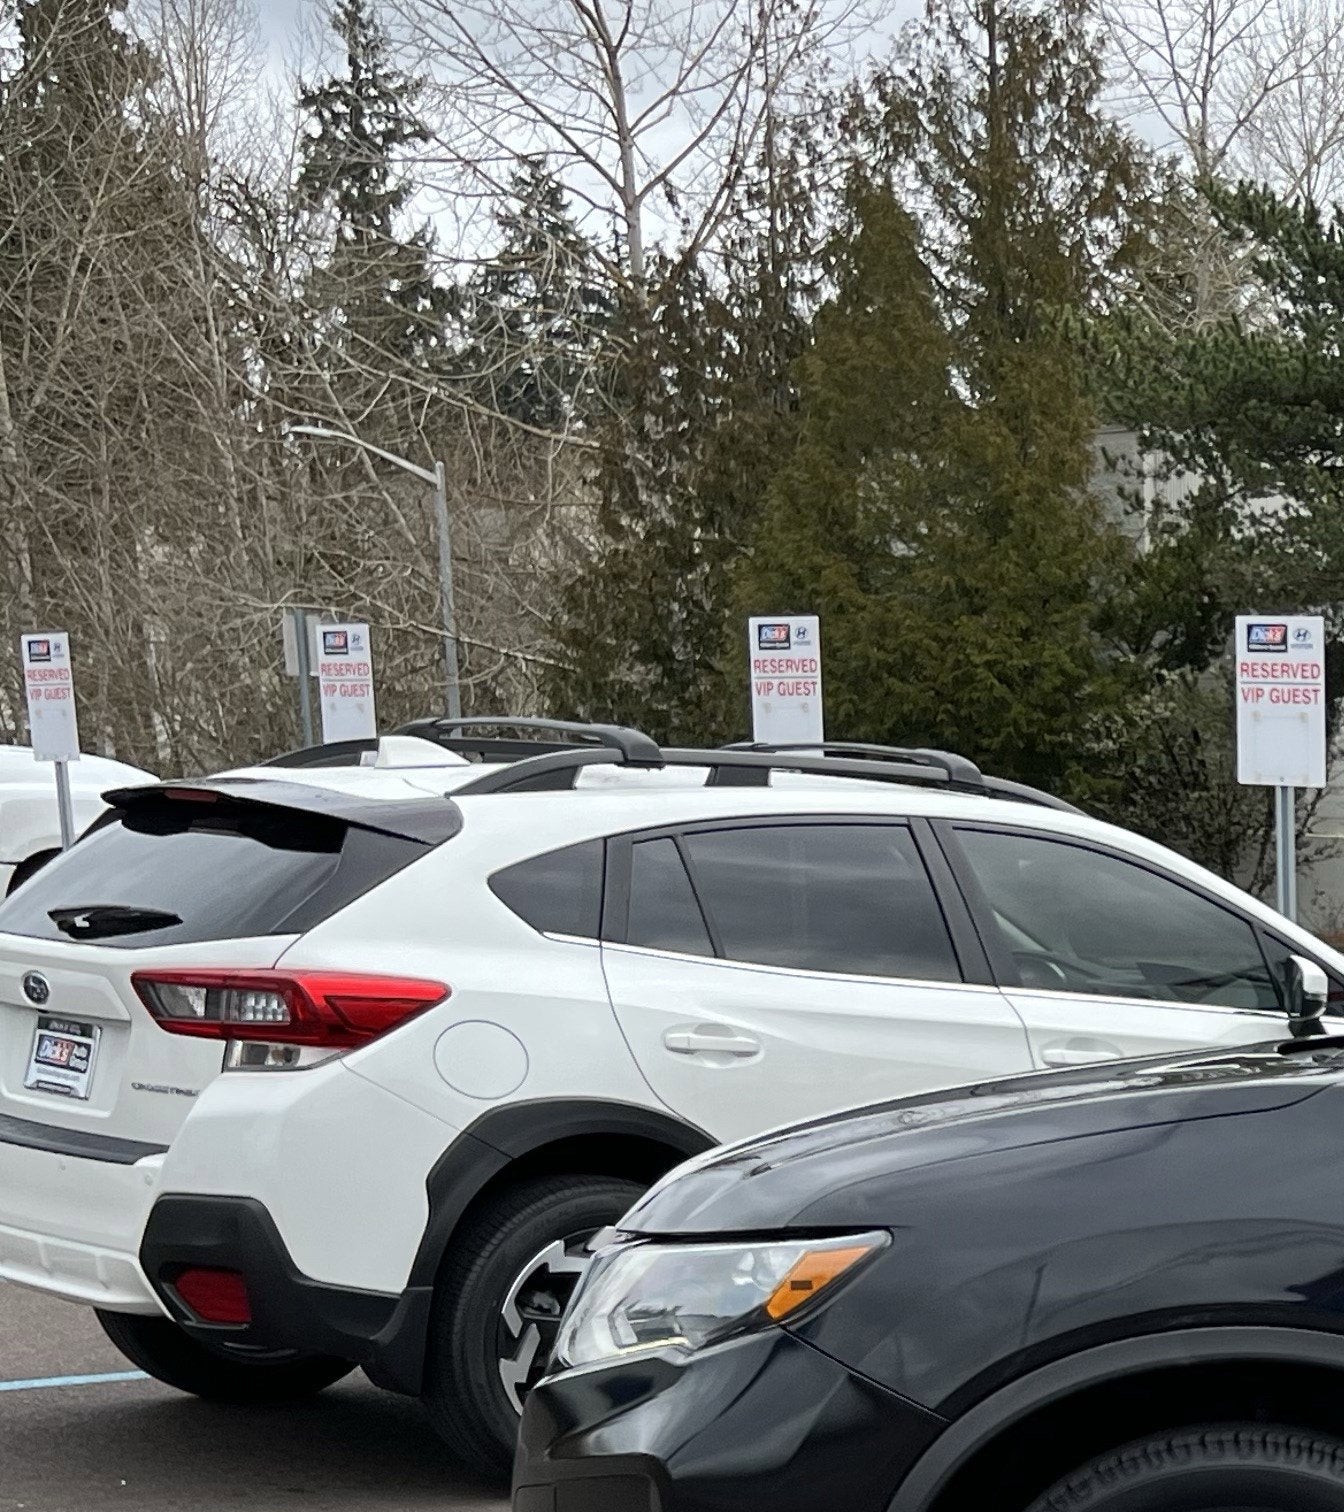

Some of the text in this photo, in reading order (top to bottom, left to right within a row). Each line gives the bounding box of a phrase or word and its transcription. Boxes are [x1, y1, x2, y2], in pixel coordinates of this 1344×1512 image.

[320, 662, 370, 676] RESERVED
[754, 658, 818, 673] RESERVED
[1240, 662, 1320, 679] RESERVED
[323, 683, 370, 697] VIP GUEST
[755, 681, 818, 696] VIP GUEST
[1241, 686, 1321, 705] VIP GUEST
